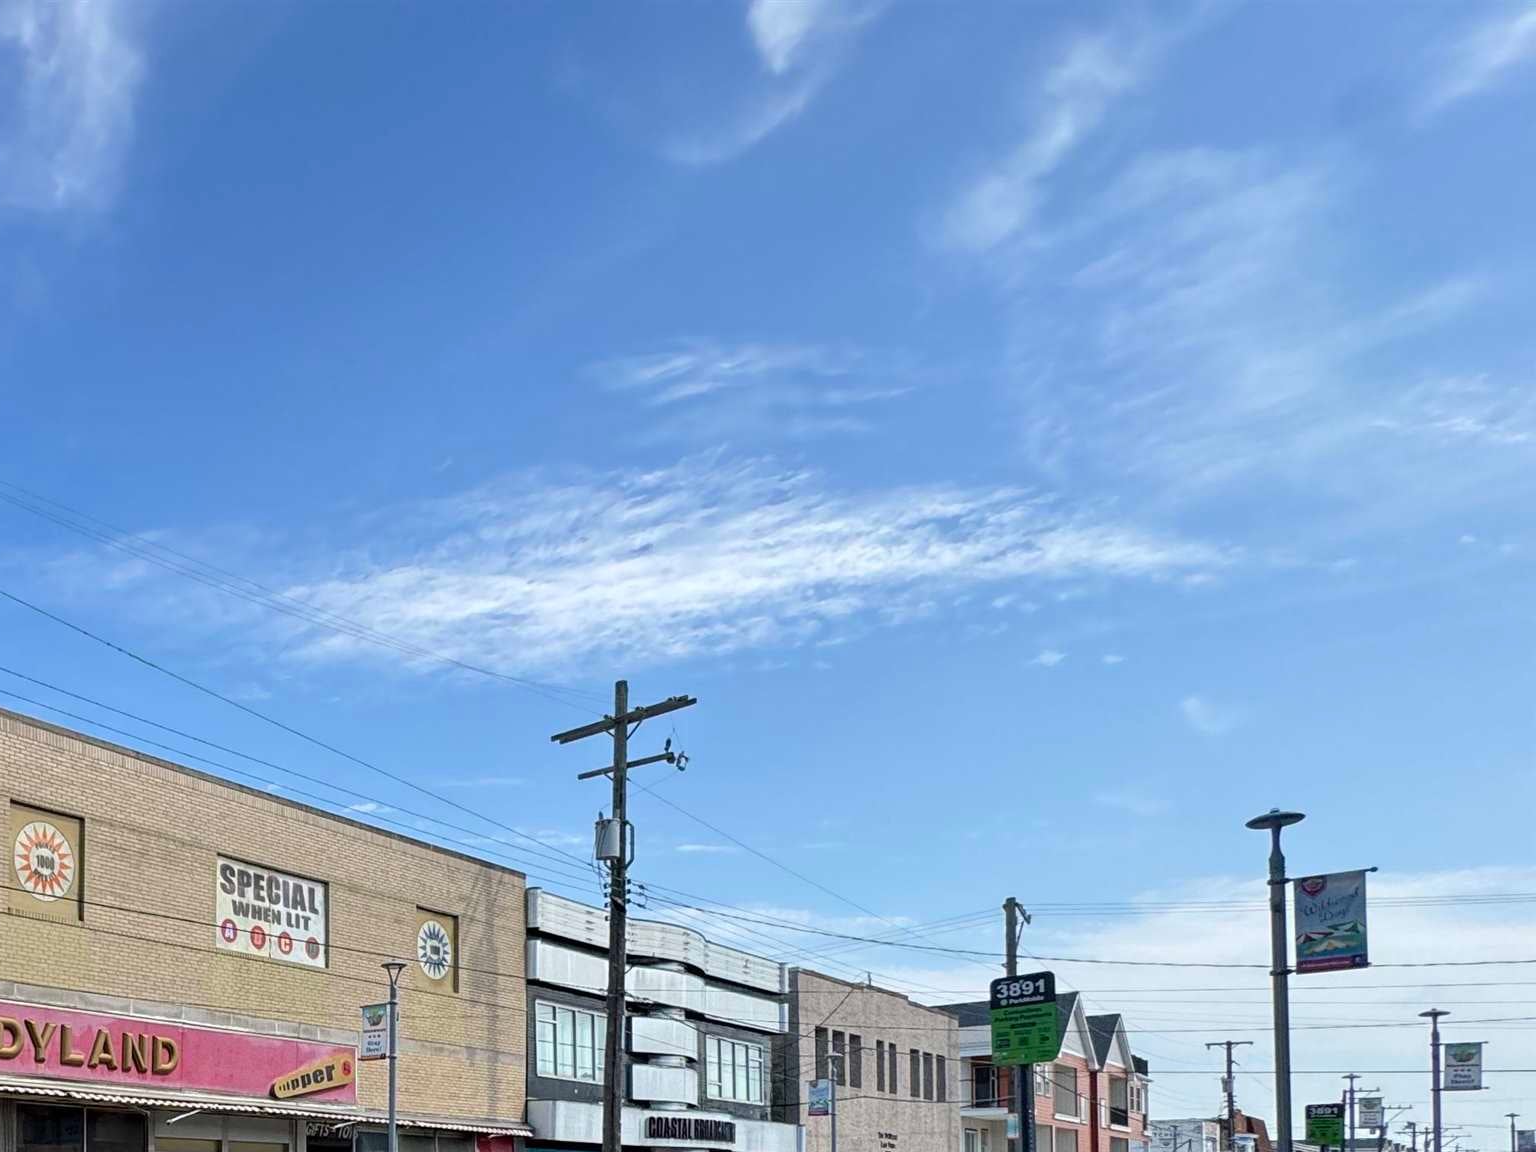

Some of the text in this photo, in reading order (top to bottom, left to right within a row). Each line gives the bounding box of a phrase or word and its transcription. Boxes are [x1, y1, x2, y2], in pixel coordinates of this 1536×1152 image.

[219, 863, 320, 916] SPECIAL
[231, 899, 312, 932] WHEN LIT
[996, 978, 1045, 999] 3891
[648, 1116, 692, 1141] COASTAL
